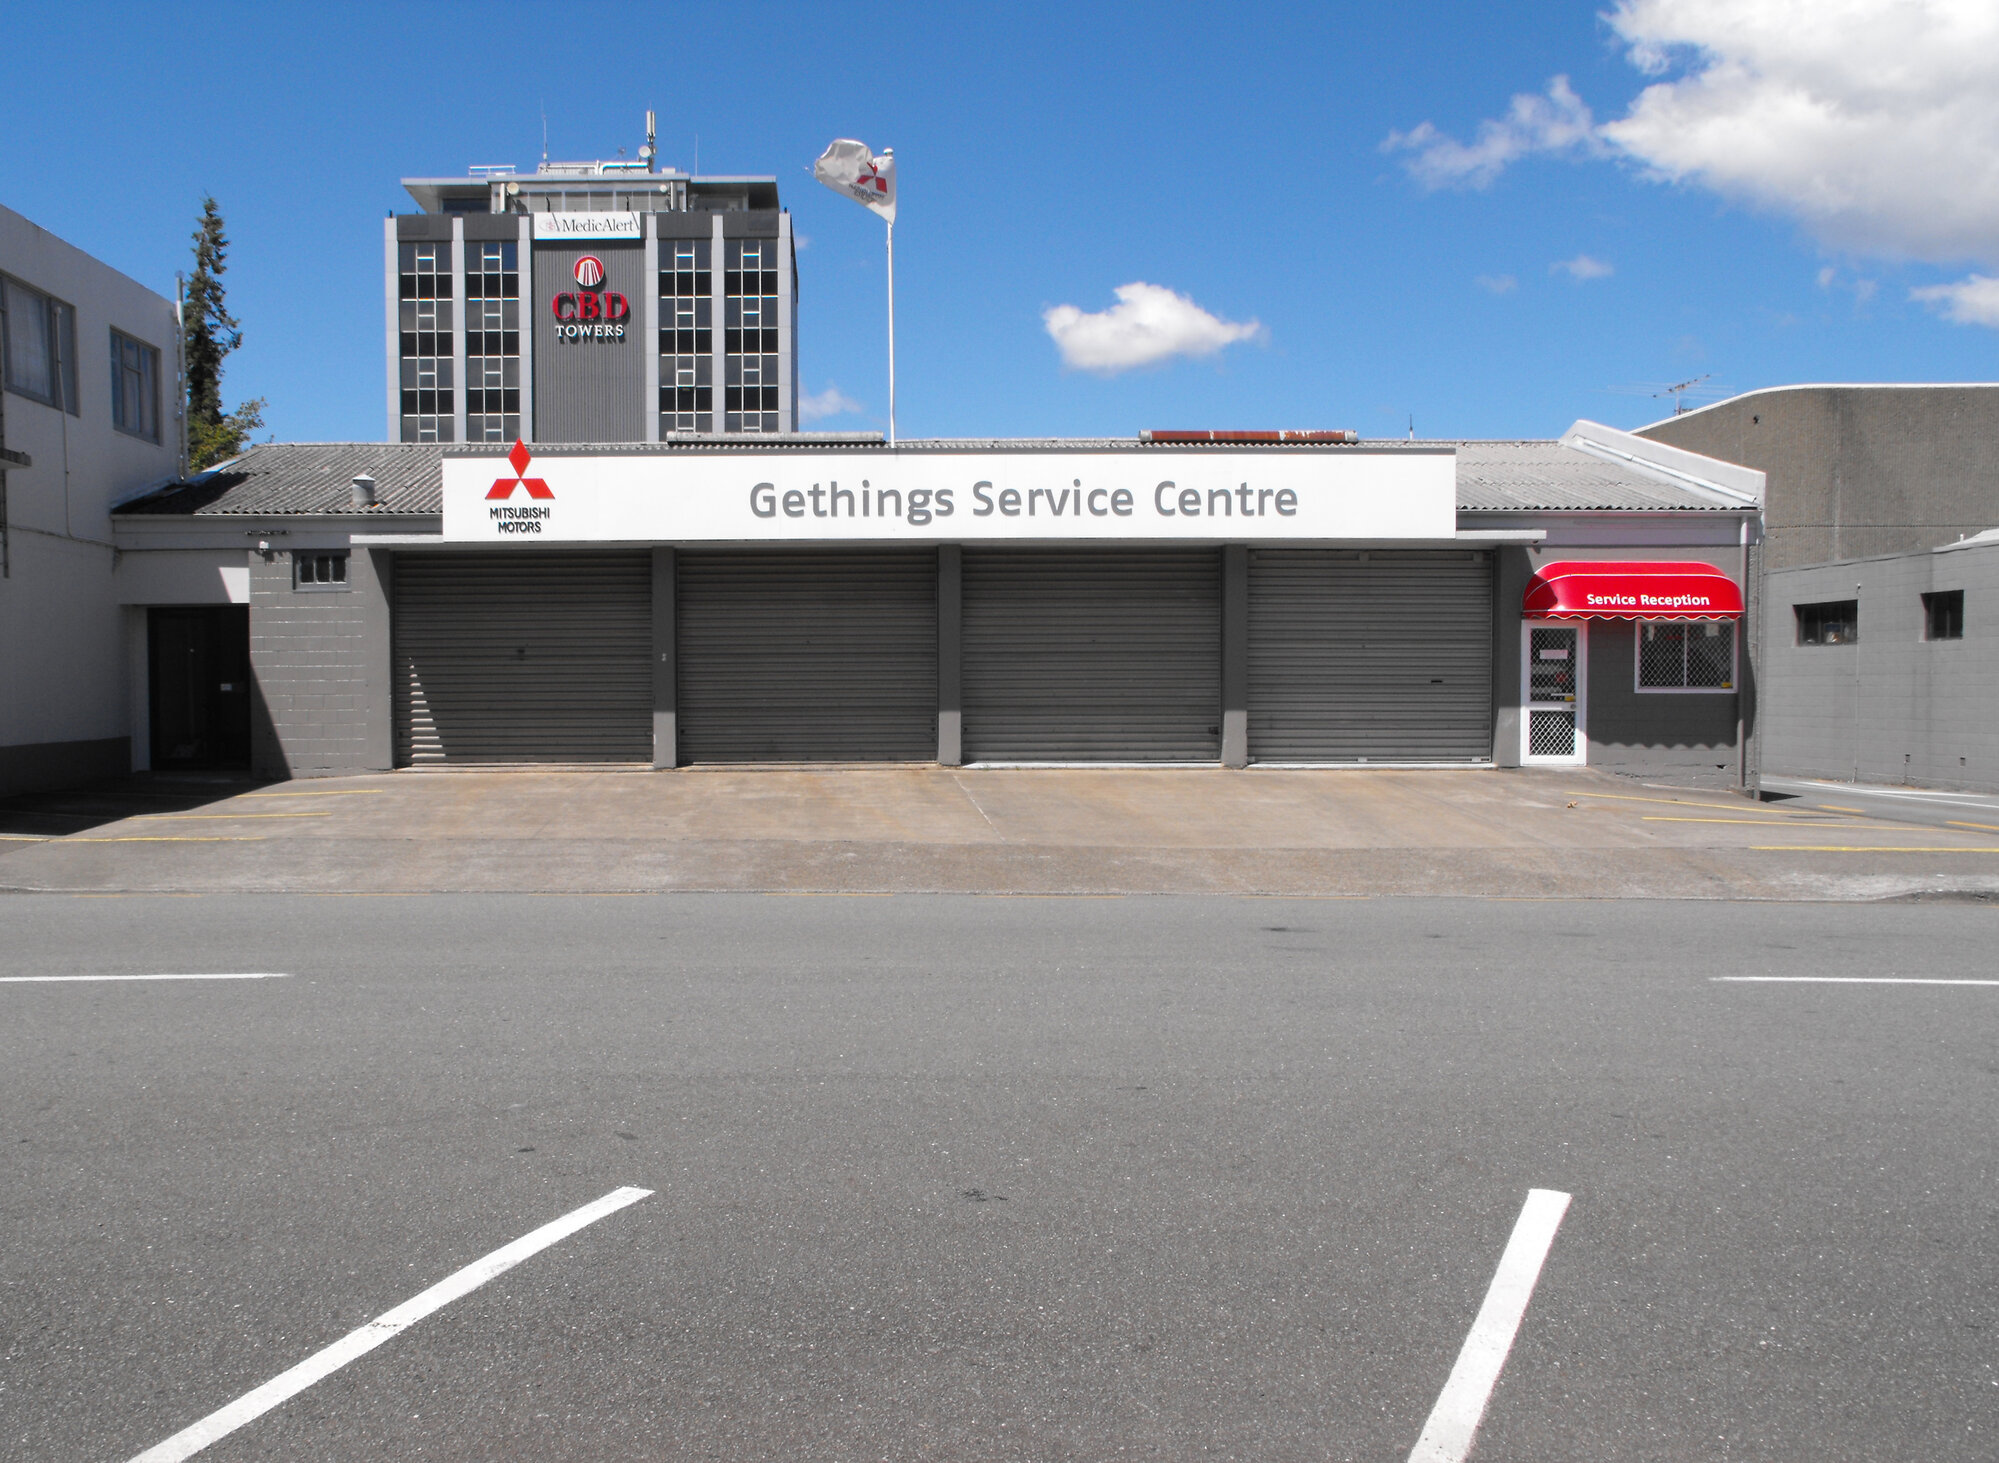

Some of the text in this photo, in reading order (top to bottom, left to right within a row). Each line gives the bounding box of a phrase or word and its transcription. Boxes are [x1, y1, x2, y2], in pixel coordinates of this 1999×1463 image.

[562, 218, 634, 233] MedicAlert
[551, 291, 628, 319] CBD
[555, 324, 625, 337] TOWERS
[750, 479, 1299, 526] Gethings Service Centre
[489, 507, 551, 519] MITSUBISHI
[498, 521, 542, 533] MOTORS
[1586, 593, 1710, 607] Service Reception
